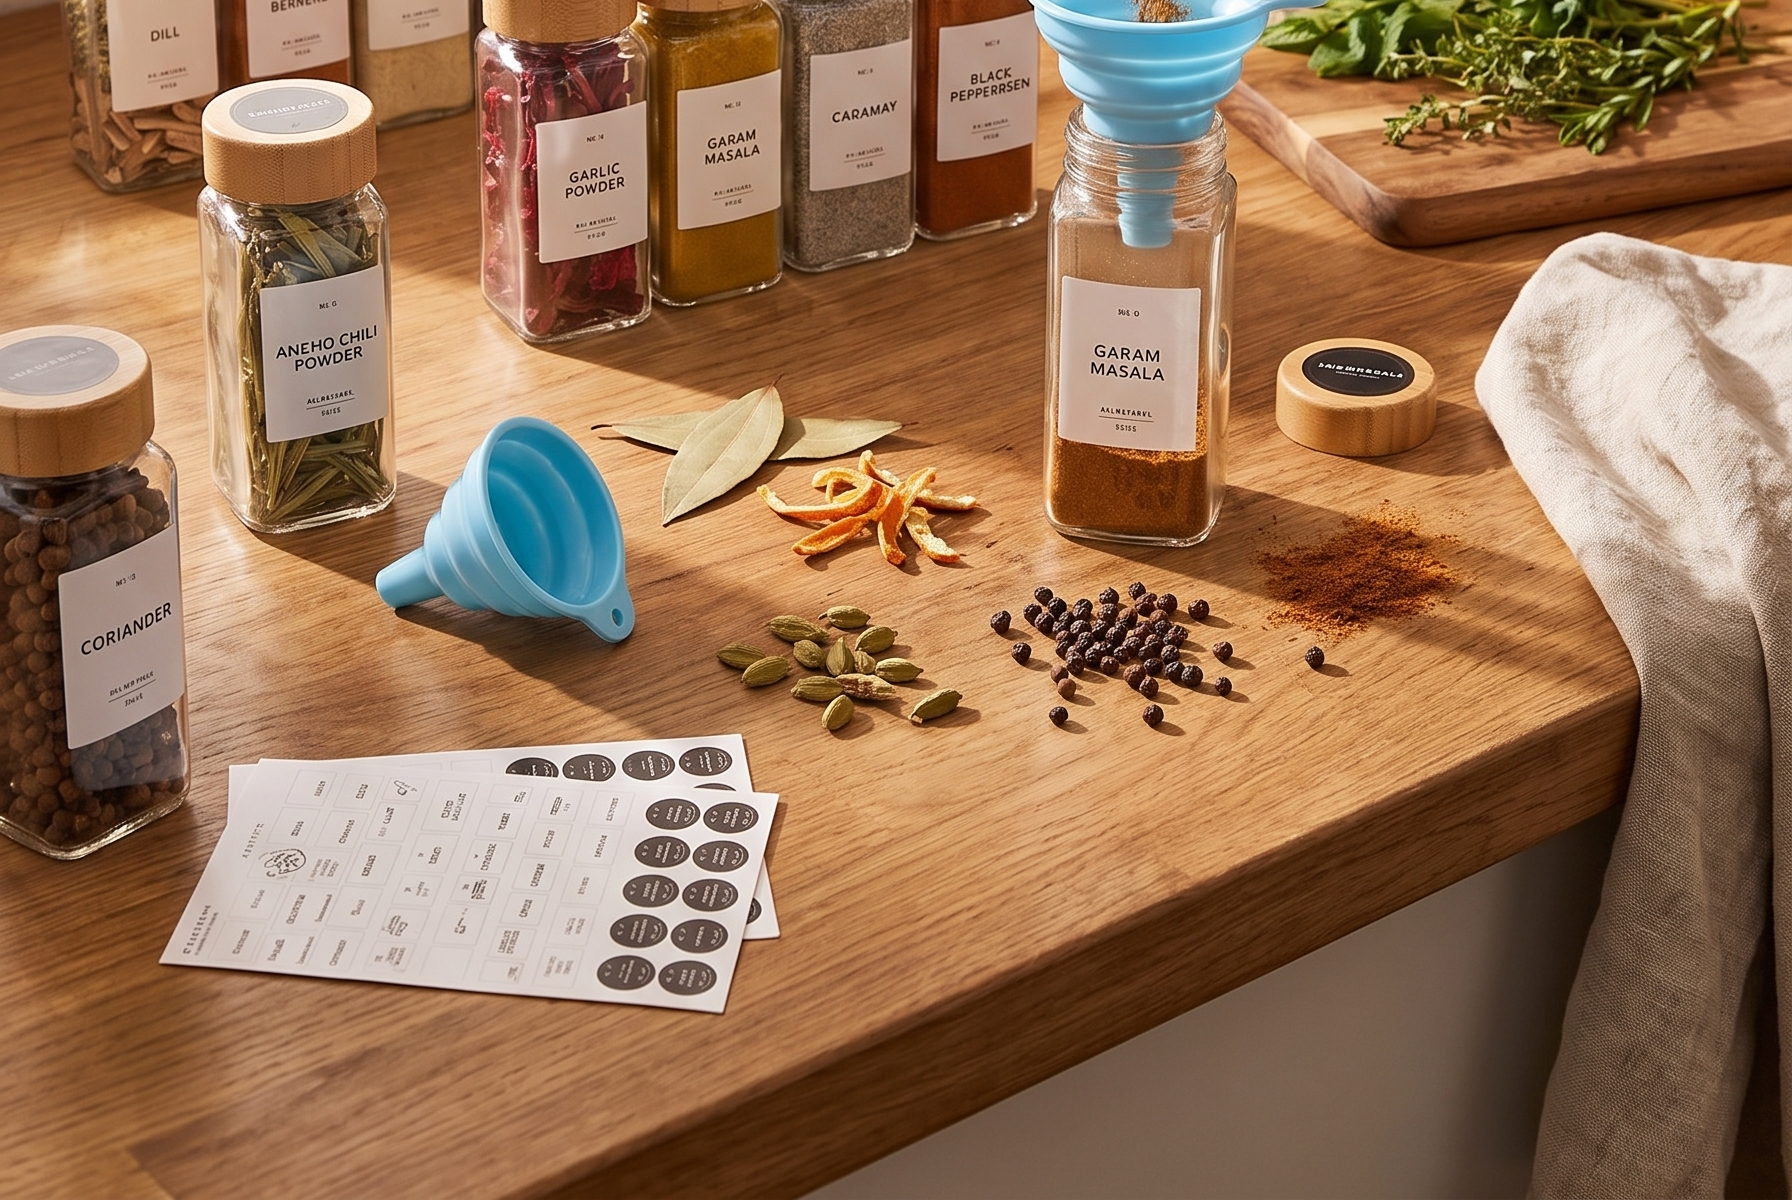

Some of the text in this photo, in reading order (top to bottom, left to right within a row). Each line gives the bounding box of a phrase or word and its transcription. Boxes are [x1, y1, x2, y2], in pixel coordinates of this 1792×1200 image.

[150, 26, 180, 43] DILL
[970, 67, 1012, 86] BLACK
[950, 77, 1031, 104] PEPPERRSEN
[832, 100, 898, 123] CARAMAY
[707, 128, 757, 150] GARAM
[704, 144, 761, 166] MASALA
[569, 162, 620, 184] GARLIC
[565, 176, 625, 200] POWDER
[275, 325, 378, 359] ANEHO CHILI
[295, 346, 363, 372] POWDER
[1094, 344, 1161, 363] GARAM
[1090, 362, 1165, 382] MASALA
[80, 602, 172, 656] CORIANDER
